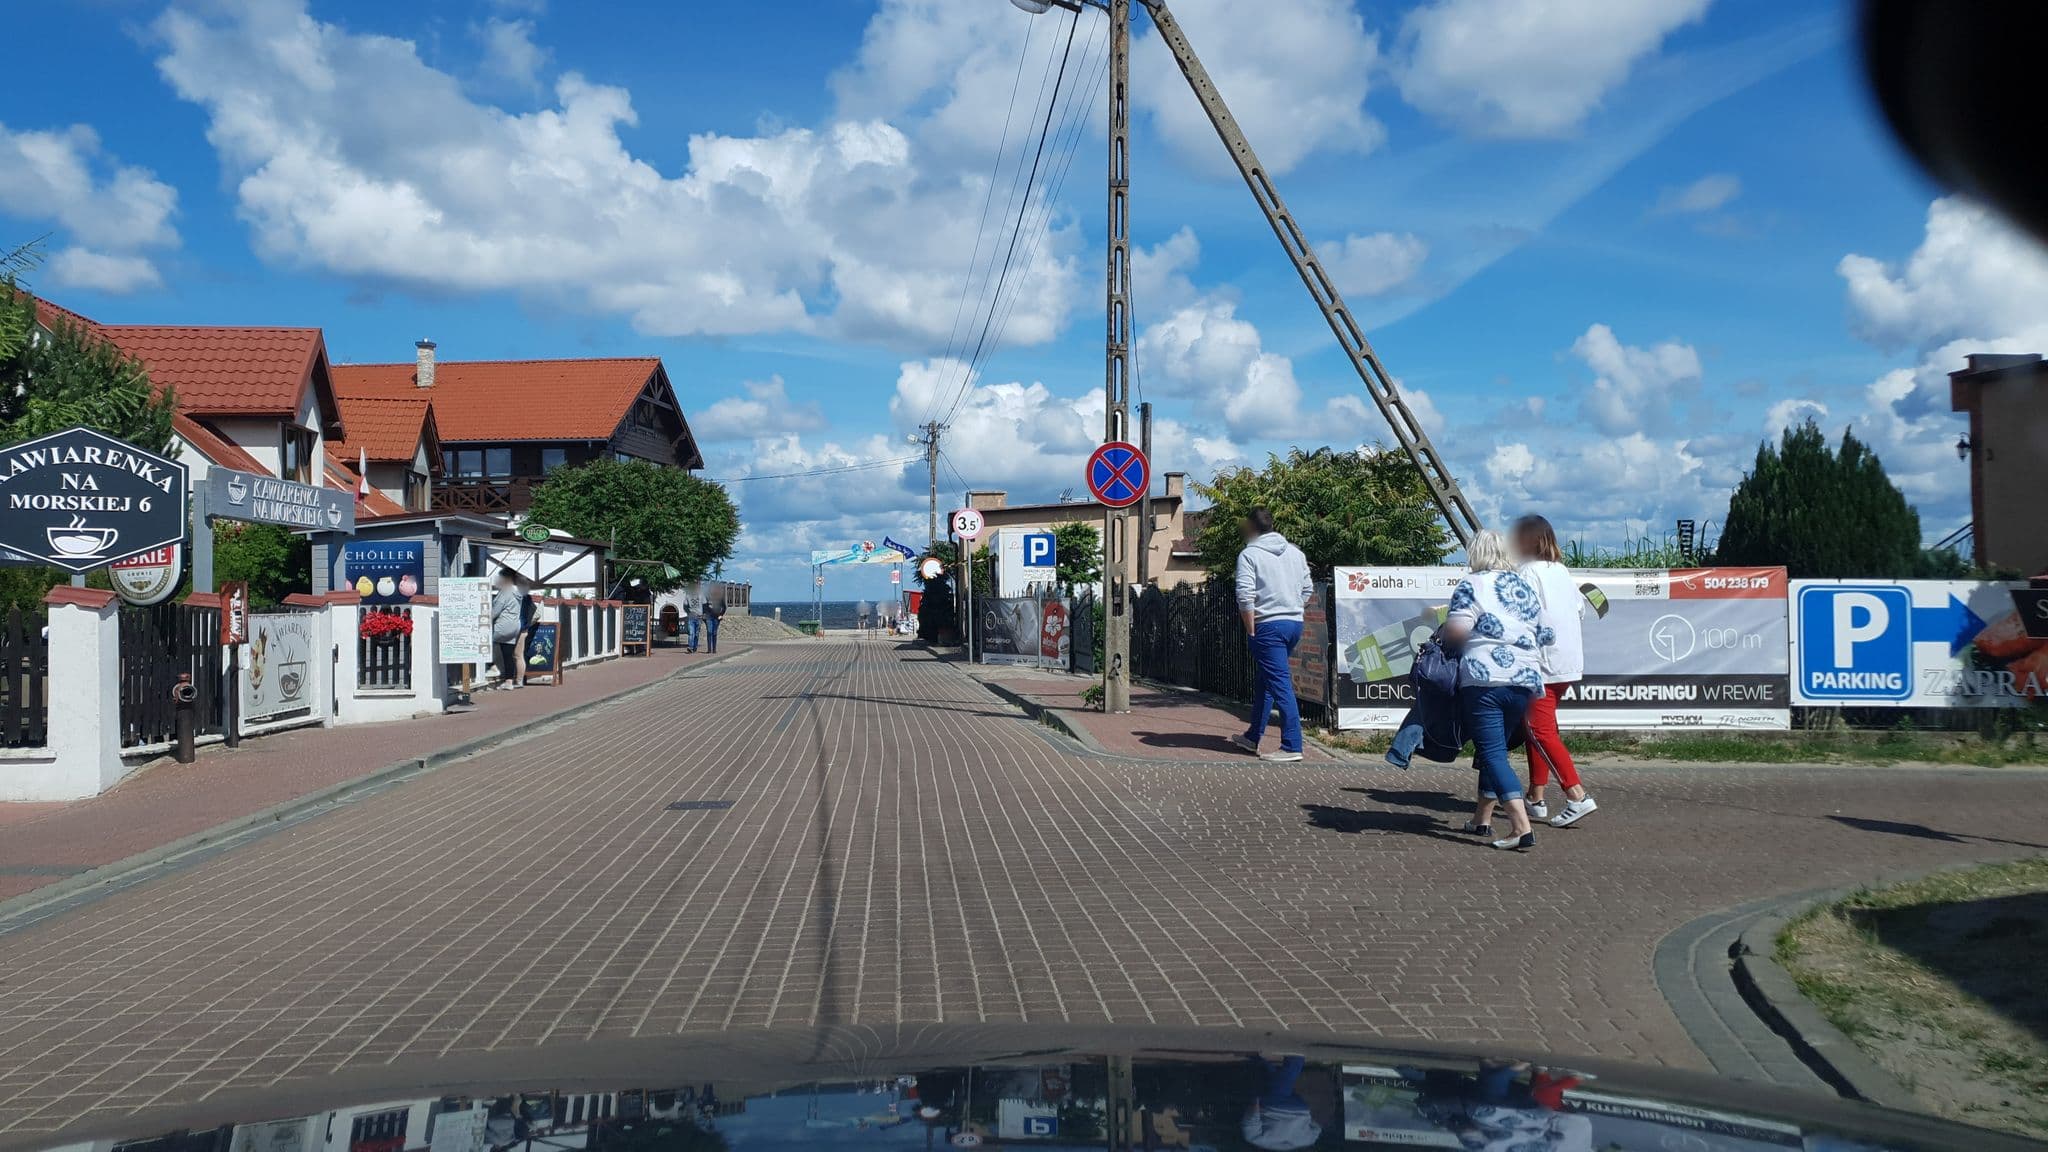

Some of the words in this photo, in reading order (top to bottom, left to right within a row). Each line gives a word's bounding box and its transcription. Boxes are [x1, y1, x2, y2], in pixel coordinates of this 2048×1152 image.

[60, 472, 100, 491] NA
[252, 478, 320, 507] KAWIARENKA
[9, 493, 131, 512] MORSKIEJ
[139, 496, 151, 513] 6
[253, 499, 268, 519] NA
[270, 501, 316, 526] MORSKIEJ
[317, 508, 323, 526] 6
[344, 548, 415, 561] CHÖLLER
[1030, 537, 1049, 564] P
[1704, 577, 1727, 590] 504
[1728, 577, 1748, 590] 238
[1749, 577, 1769, 589] 179
[1701, 628, 1738, 649] 100
[1742, 633, 1762, 649] m
[1833, 592, 1890, 668] P
[1811, 671, 1902, 690] PARKING
[1923, 668, 2048, 697] ZAPRA
[1356, 684, 1417, 700] LICENC
[1581, 685, 1698, 701] KITESURFINGU
[1703, 685, 1721, 700] W
[1724, 684, 1774, 700] REWIE
